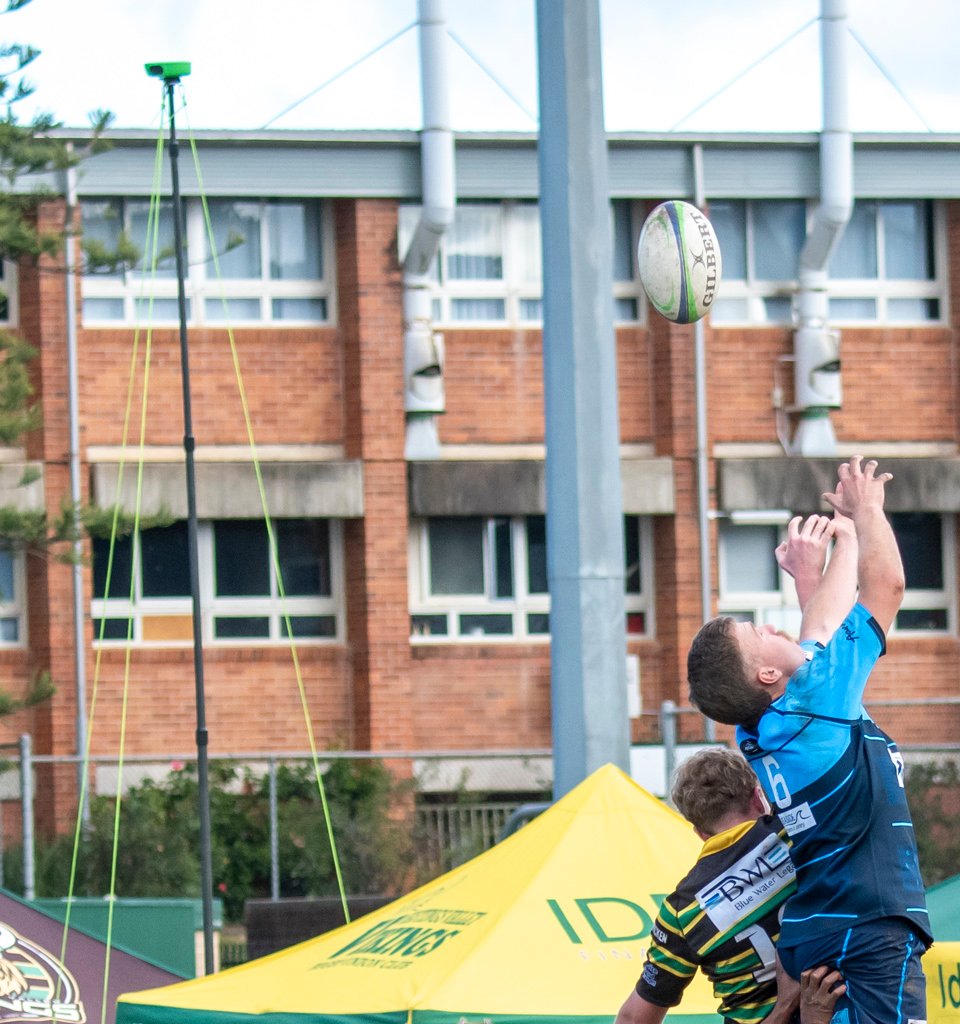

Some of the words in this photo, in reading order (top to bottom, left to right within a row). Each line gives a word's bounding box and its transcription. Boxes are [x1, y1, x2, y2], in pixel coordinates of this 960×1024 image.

[690, 212, 717, 307] GILBERT
[762, 754, 792, 810] 6
[734, 895, 753, 911] Blue
[752, 877, 776, 896] Water
[776, 863, 796, 879] Lega
